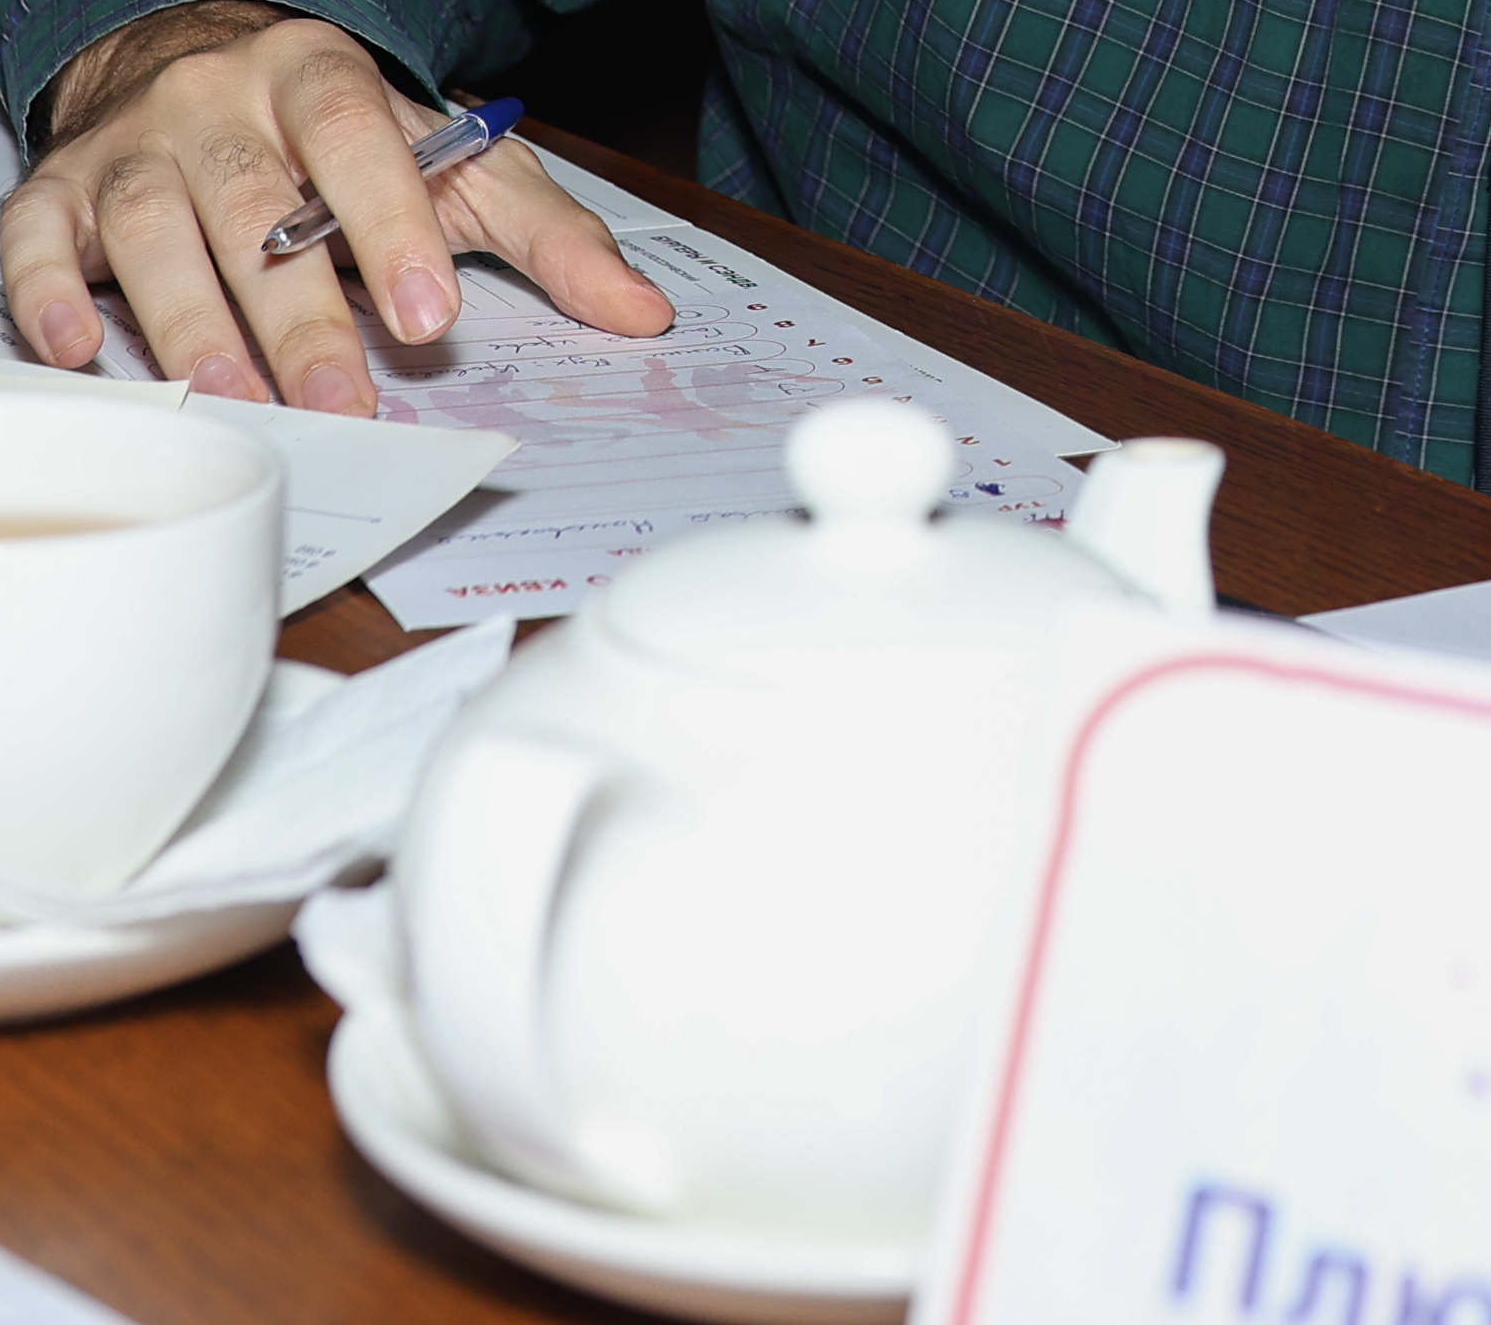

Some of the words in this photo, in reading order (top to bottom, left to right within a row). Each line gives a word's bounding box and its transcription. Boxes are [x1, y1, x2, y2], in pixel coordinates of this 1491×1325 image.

[773, 320, 796, 328] 8
[807, 338, 826, 348] 7
[861, 376, 884, 385] 5
[955, 435, 981, 446] 2
[445, 578, 568, 598] КВИЗА
